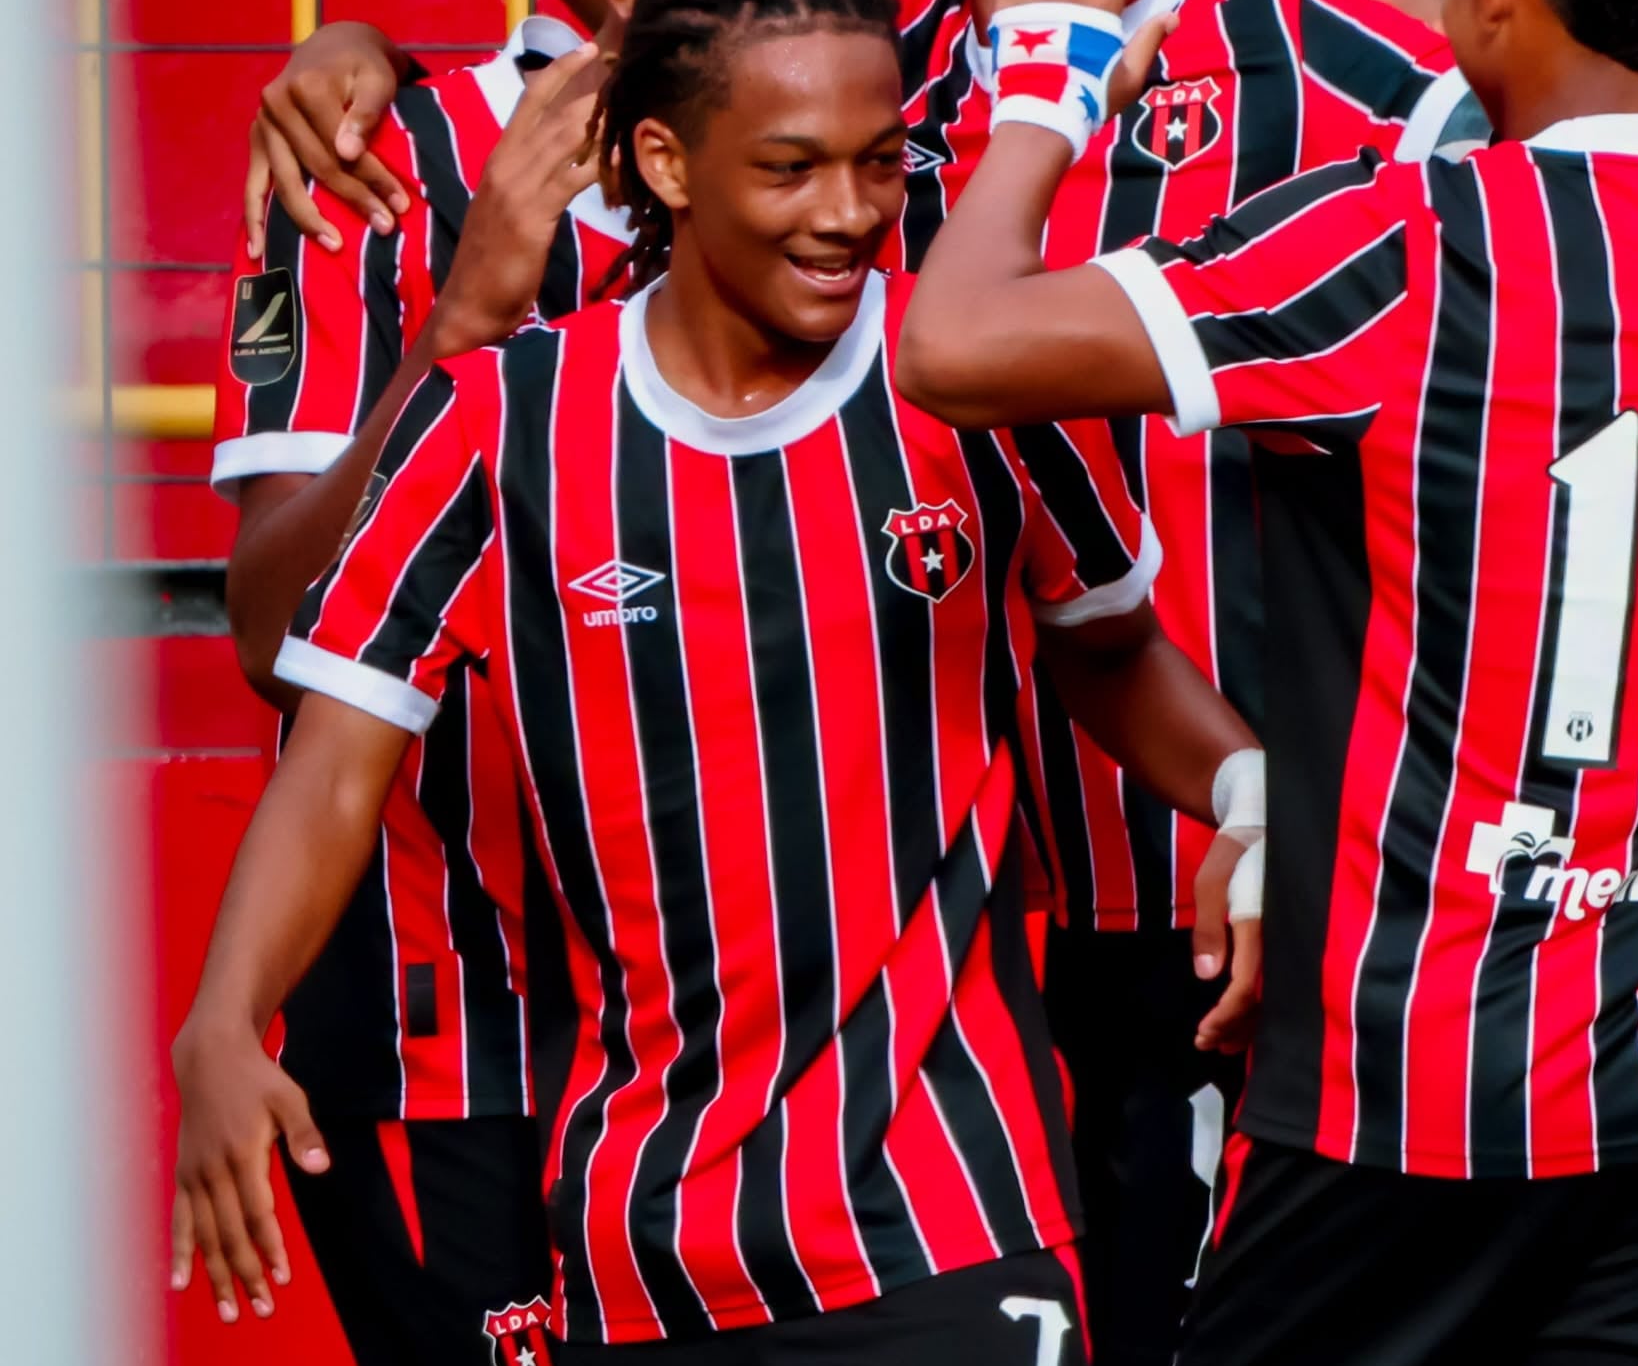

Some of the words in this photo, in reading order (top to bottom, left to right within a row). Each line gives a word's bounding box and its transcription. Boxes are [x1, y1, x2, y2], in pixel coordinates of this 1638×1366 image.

[1155, 87, 1203, 106] LDA
[900, 513, 952, 535] LDA
[583, 605, 658, 628] umbro
[494, 1311, 540, 1336] LDA
